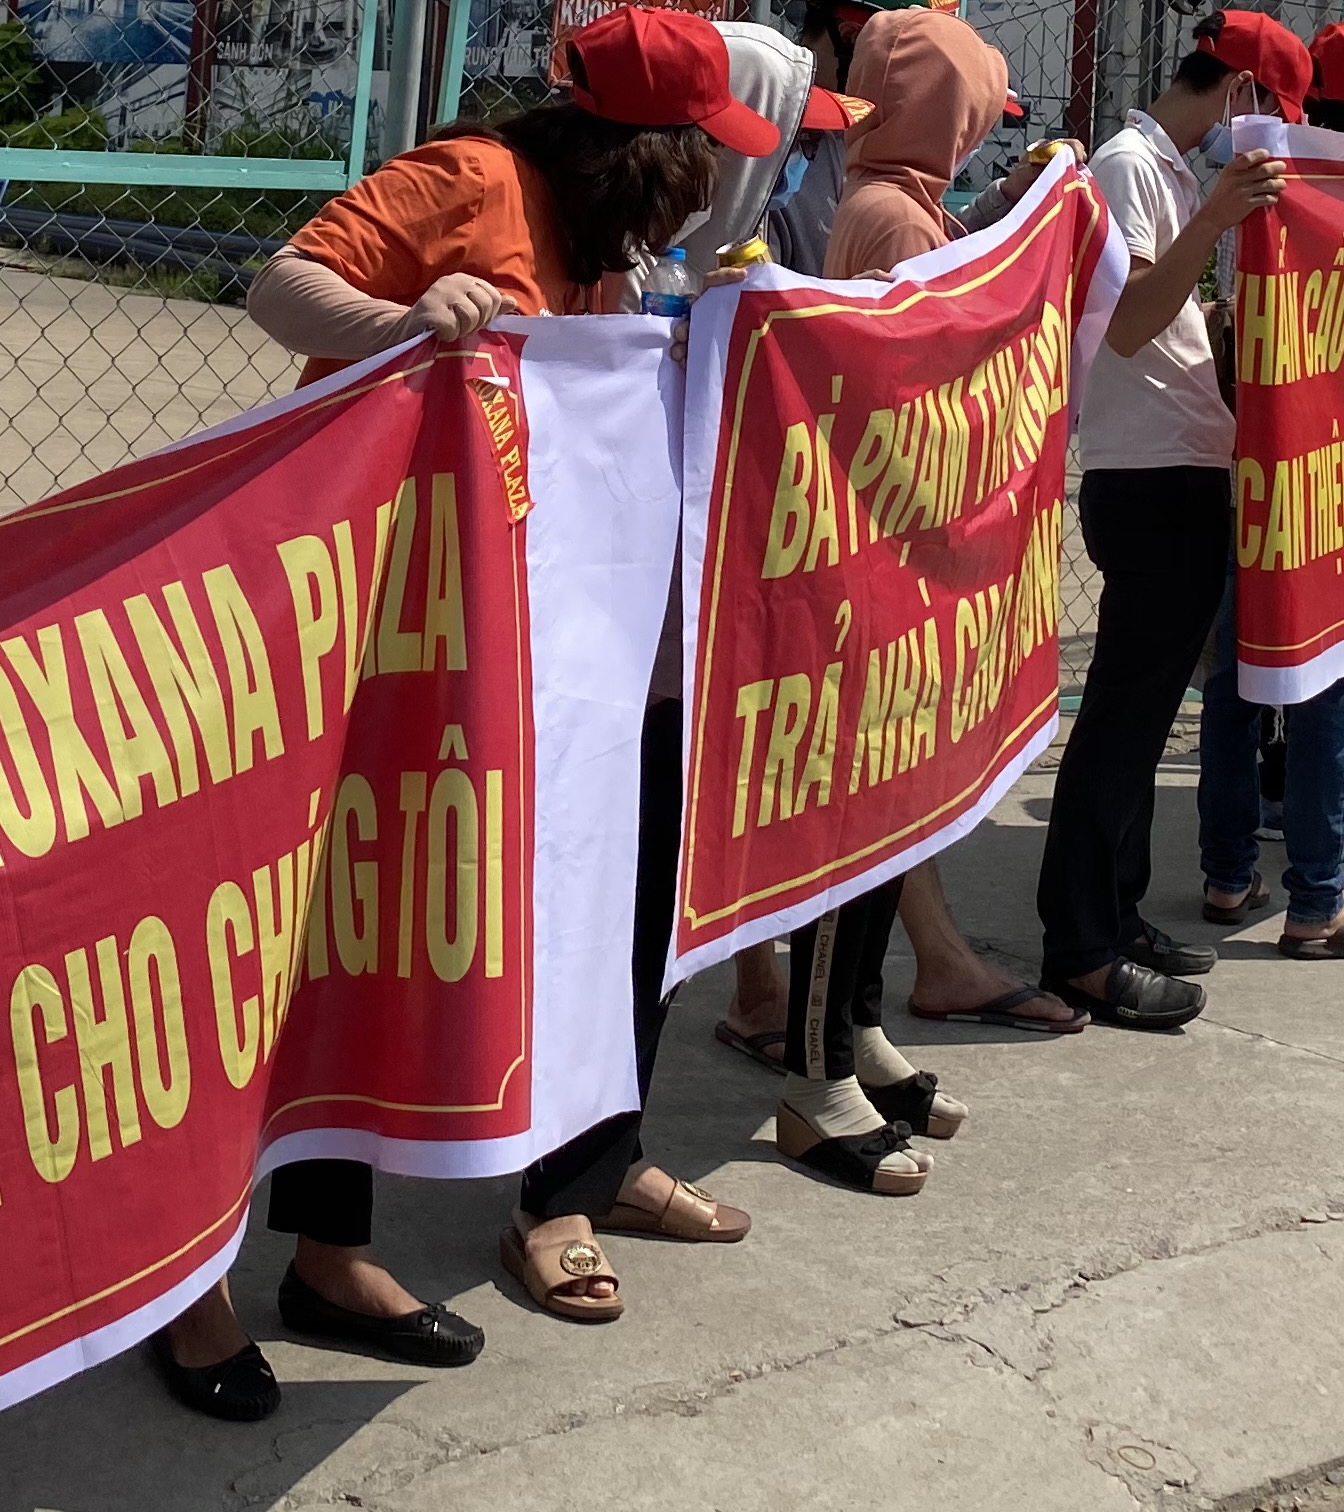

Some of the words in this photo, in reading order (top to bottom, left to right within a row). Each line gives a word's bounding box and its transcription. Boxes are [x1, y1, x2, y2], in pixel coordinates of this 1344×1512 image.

[500, 445, 528, 520] PLAZA
[848, 376, 970, 568] PHẠM
[1236, 457, 1306, 572] CAN
[730, 599, 851, 840] TRẢ
[848, 576, 942, 795] NHÀ
[10, 914, 191, 1184] CHO
[398, 723, 504, 983] TÔI
[814, 934, 830, 980] CHANEL
[810, 1018, 820, 1064] CHANEL
